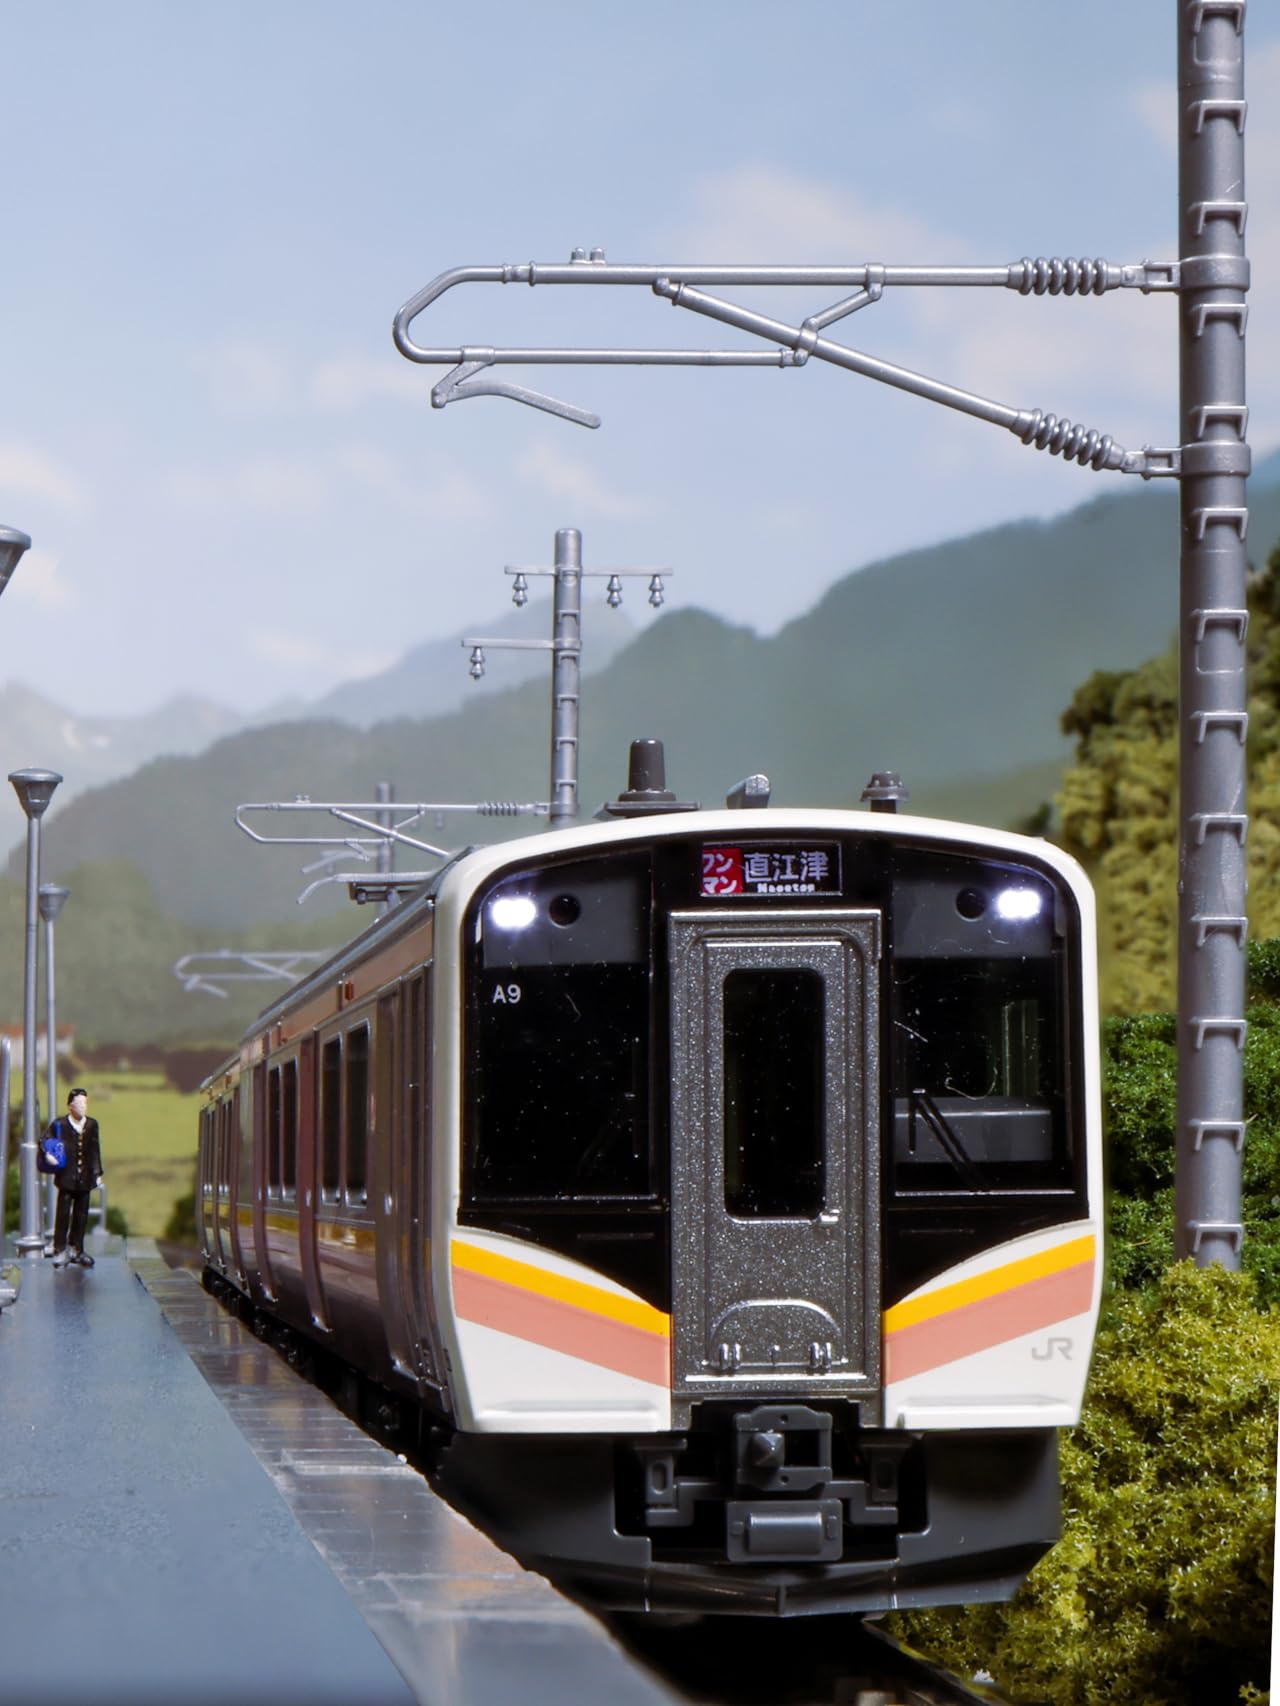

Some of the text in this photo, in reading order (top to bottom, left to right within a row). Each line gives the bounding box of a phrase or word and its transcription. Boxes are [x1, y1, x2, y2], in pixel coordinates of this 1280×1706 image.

[743, 851, 829, 884] 直江津
[492, 984, 522, 1004] A9
[1031, 1337, 1073, 1361] JR
